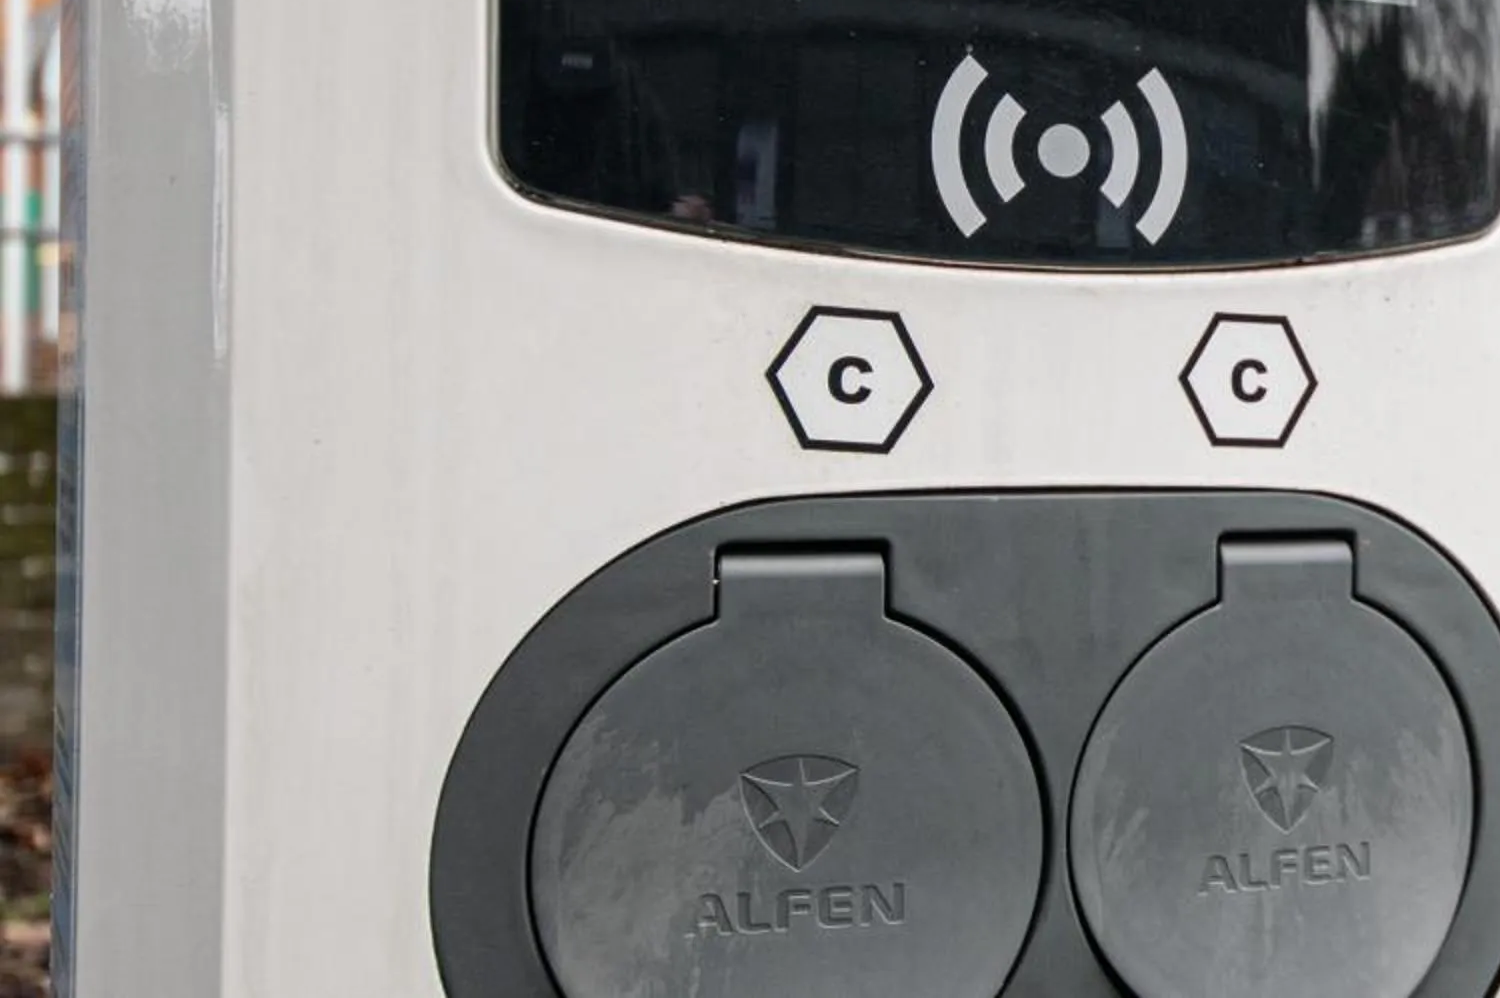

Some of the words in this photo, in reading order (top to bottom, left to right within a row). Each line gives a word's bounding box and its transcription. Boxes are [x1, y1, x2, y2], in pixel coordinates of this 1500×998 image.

[826, 355, 874, 405] C
[1230, 358, 1268, 403] C
[1198, 841, 1371, 897] ALFEN
[684, 882, 906, 939] ALFEN
